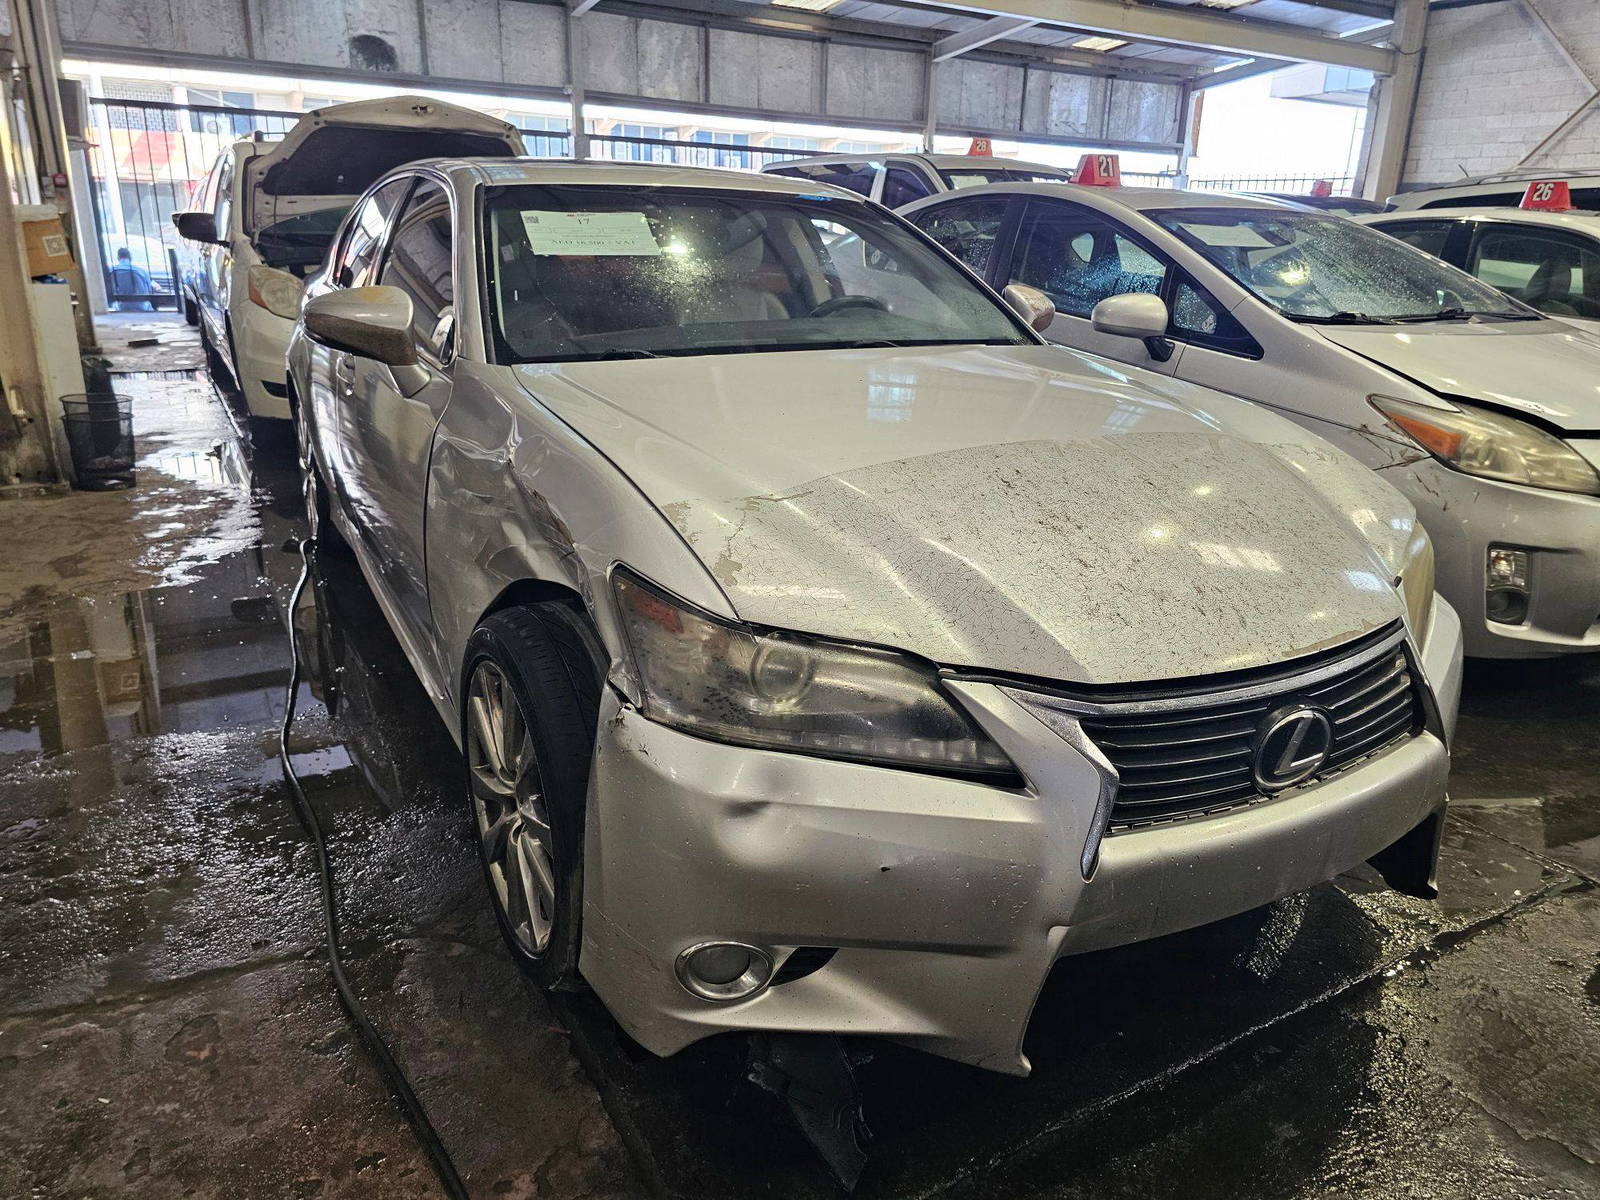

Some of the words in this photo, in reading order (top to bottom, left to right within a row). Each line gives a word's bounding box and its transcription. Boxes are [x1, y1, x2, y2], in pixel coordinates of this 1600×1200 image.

[976, 140, 986, 151] 28
[1097, 155, 1114, 176] 21
[1532, 183, 1555, 201] 26
